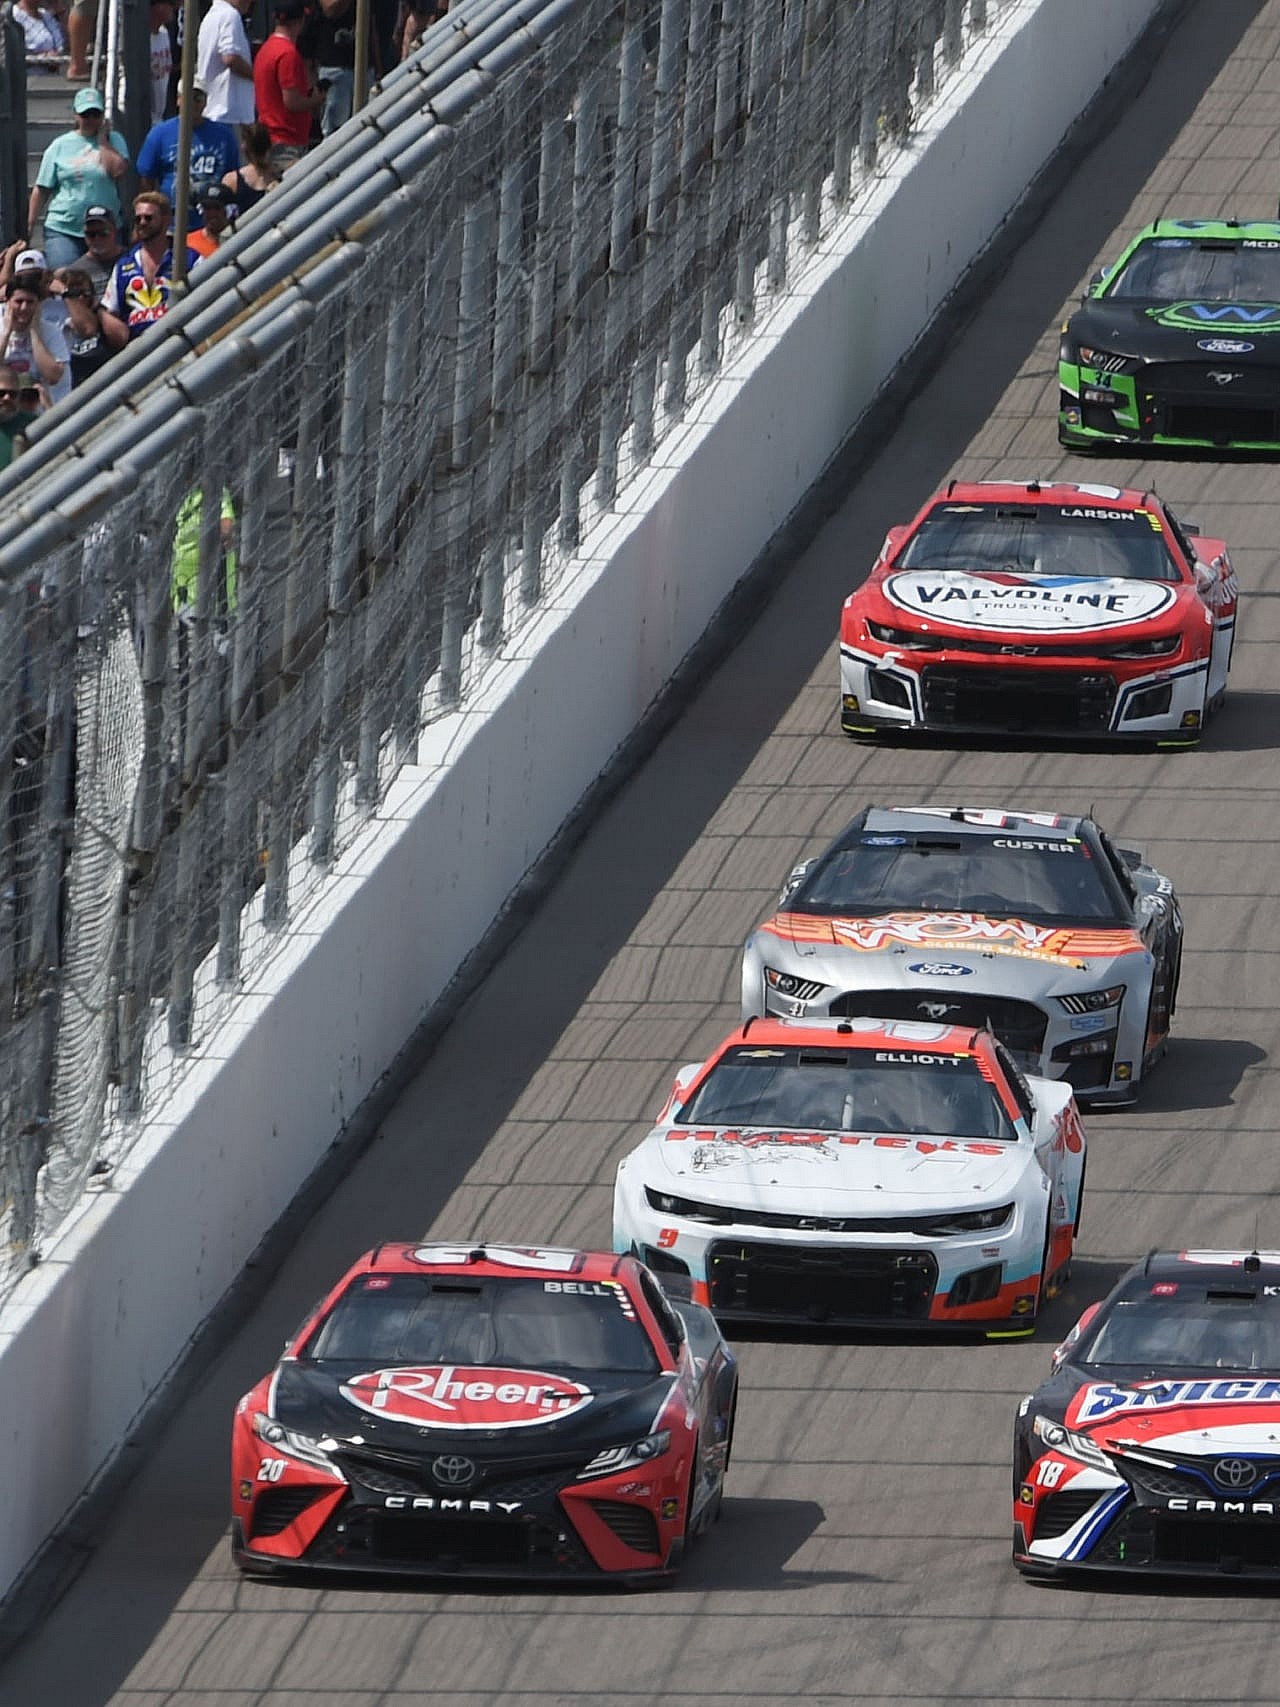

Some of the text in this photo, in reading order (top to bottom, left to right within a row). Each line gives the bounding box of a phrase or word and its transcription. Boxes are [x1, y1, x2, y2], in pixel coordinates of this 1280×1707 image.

[1061, 508, 1135, 521] LARSON
[916, 586, 1132, 614] VALVOLINE
[982, 602, 1065, 614] TRUSTED
[993, 839, 1075, 853] CUSTER
[919, 962, 965, 976] Ford
[788, 1001, 808, 1018] 41
[875, 1052, 962, 1066] ELLIOTT
[657, 1228, 679, 1248] 9
[544, 1281, 611, 1297] BELL
[371, 1366, 571, 1410] Rheem
[257, 1458, 287, 1482] 20
[1036, 1460, 1067, 1488] 18
[385, 1496, 523, 1514] CAMRY
